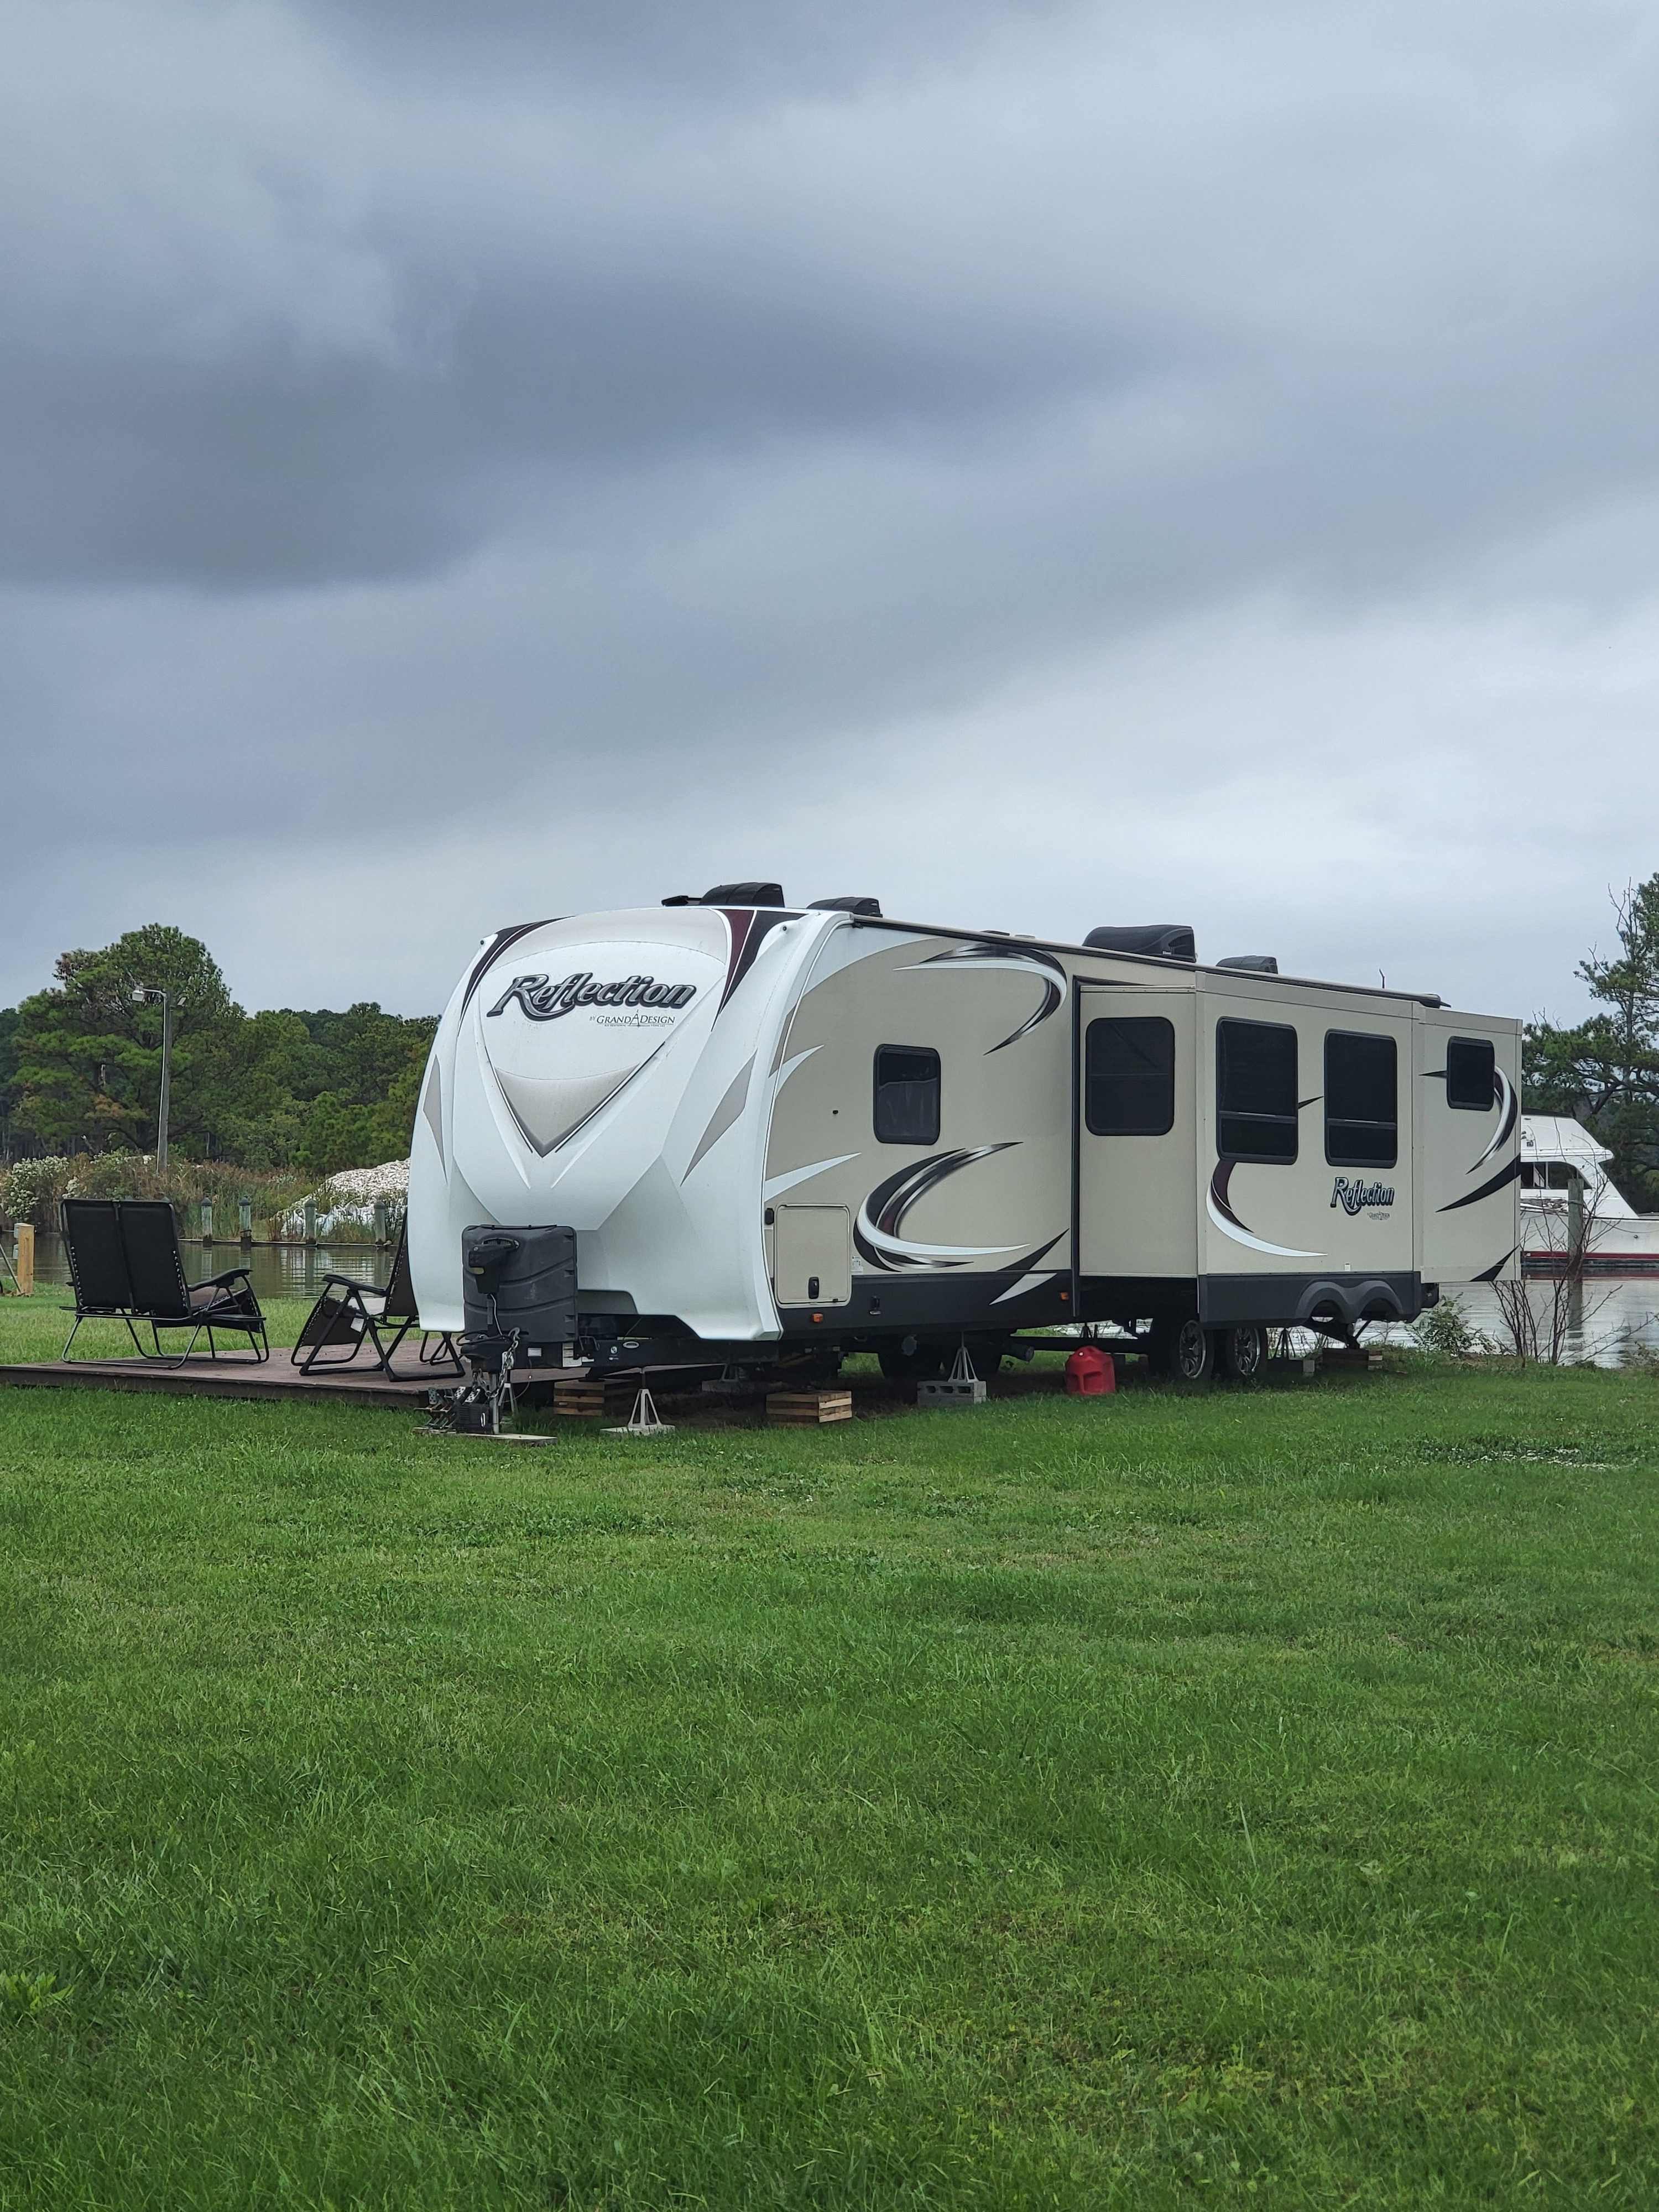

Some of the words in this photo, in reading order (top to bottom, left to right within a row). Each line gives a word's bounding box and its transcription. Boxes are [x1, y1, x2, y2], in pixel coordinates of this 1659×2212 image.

[486, 972, 696, 1021] Reflection
[596, 1015, 632, 1024] GRAND
[640, 1015, 675, 1024] DESIGN
[1330, 1177, 1395, 1215] Reflection
